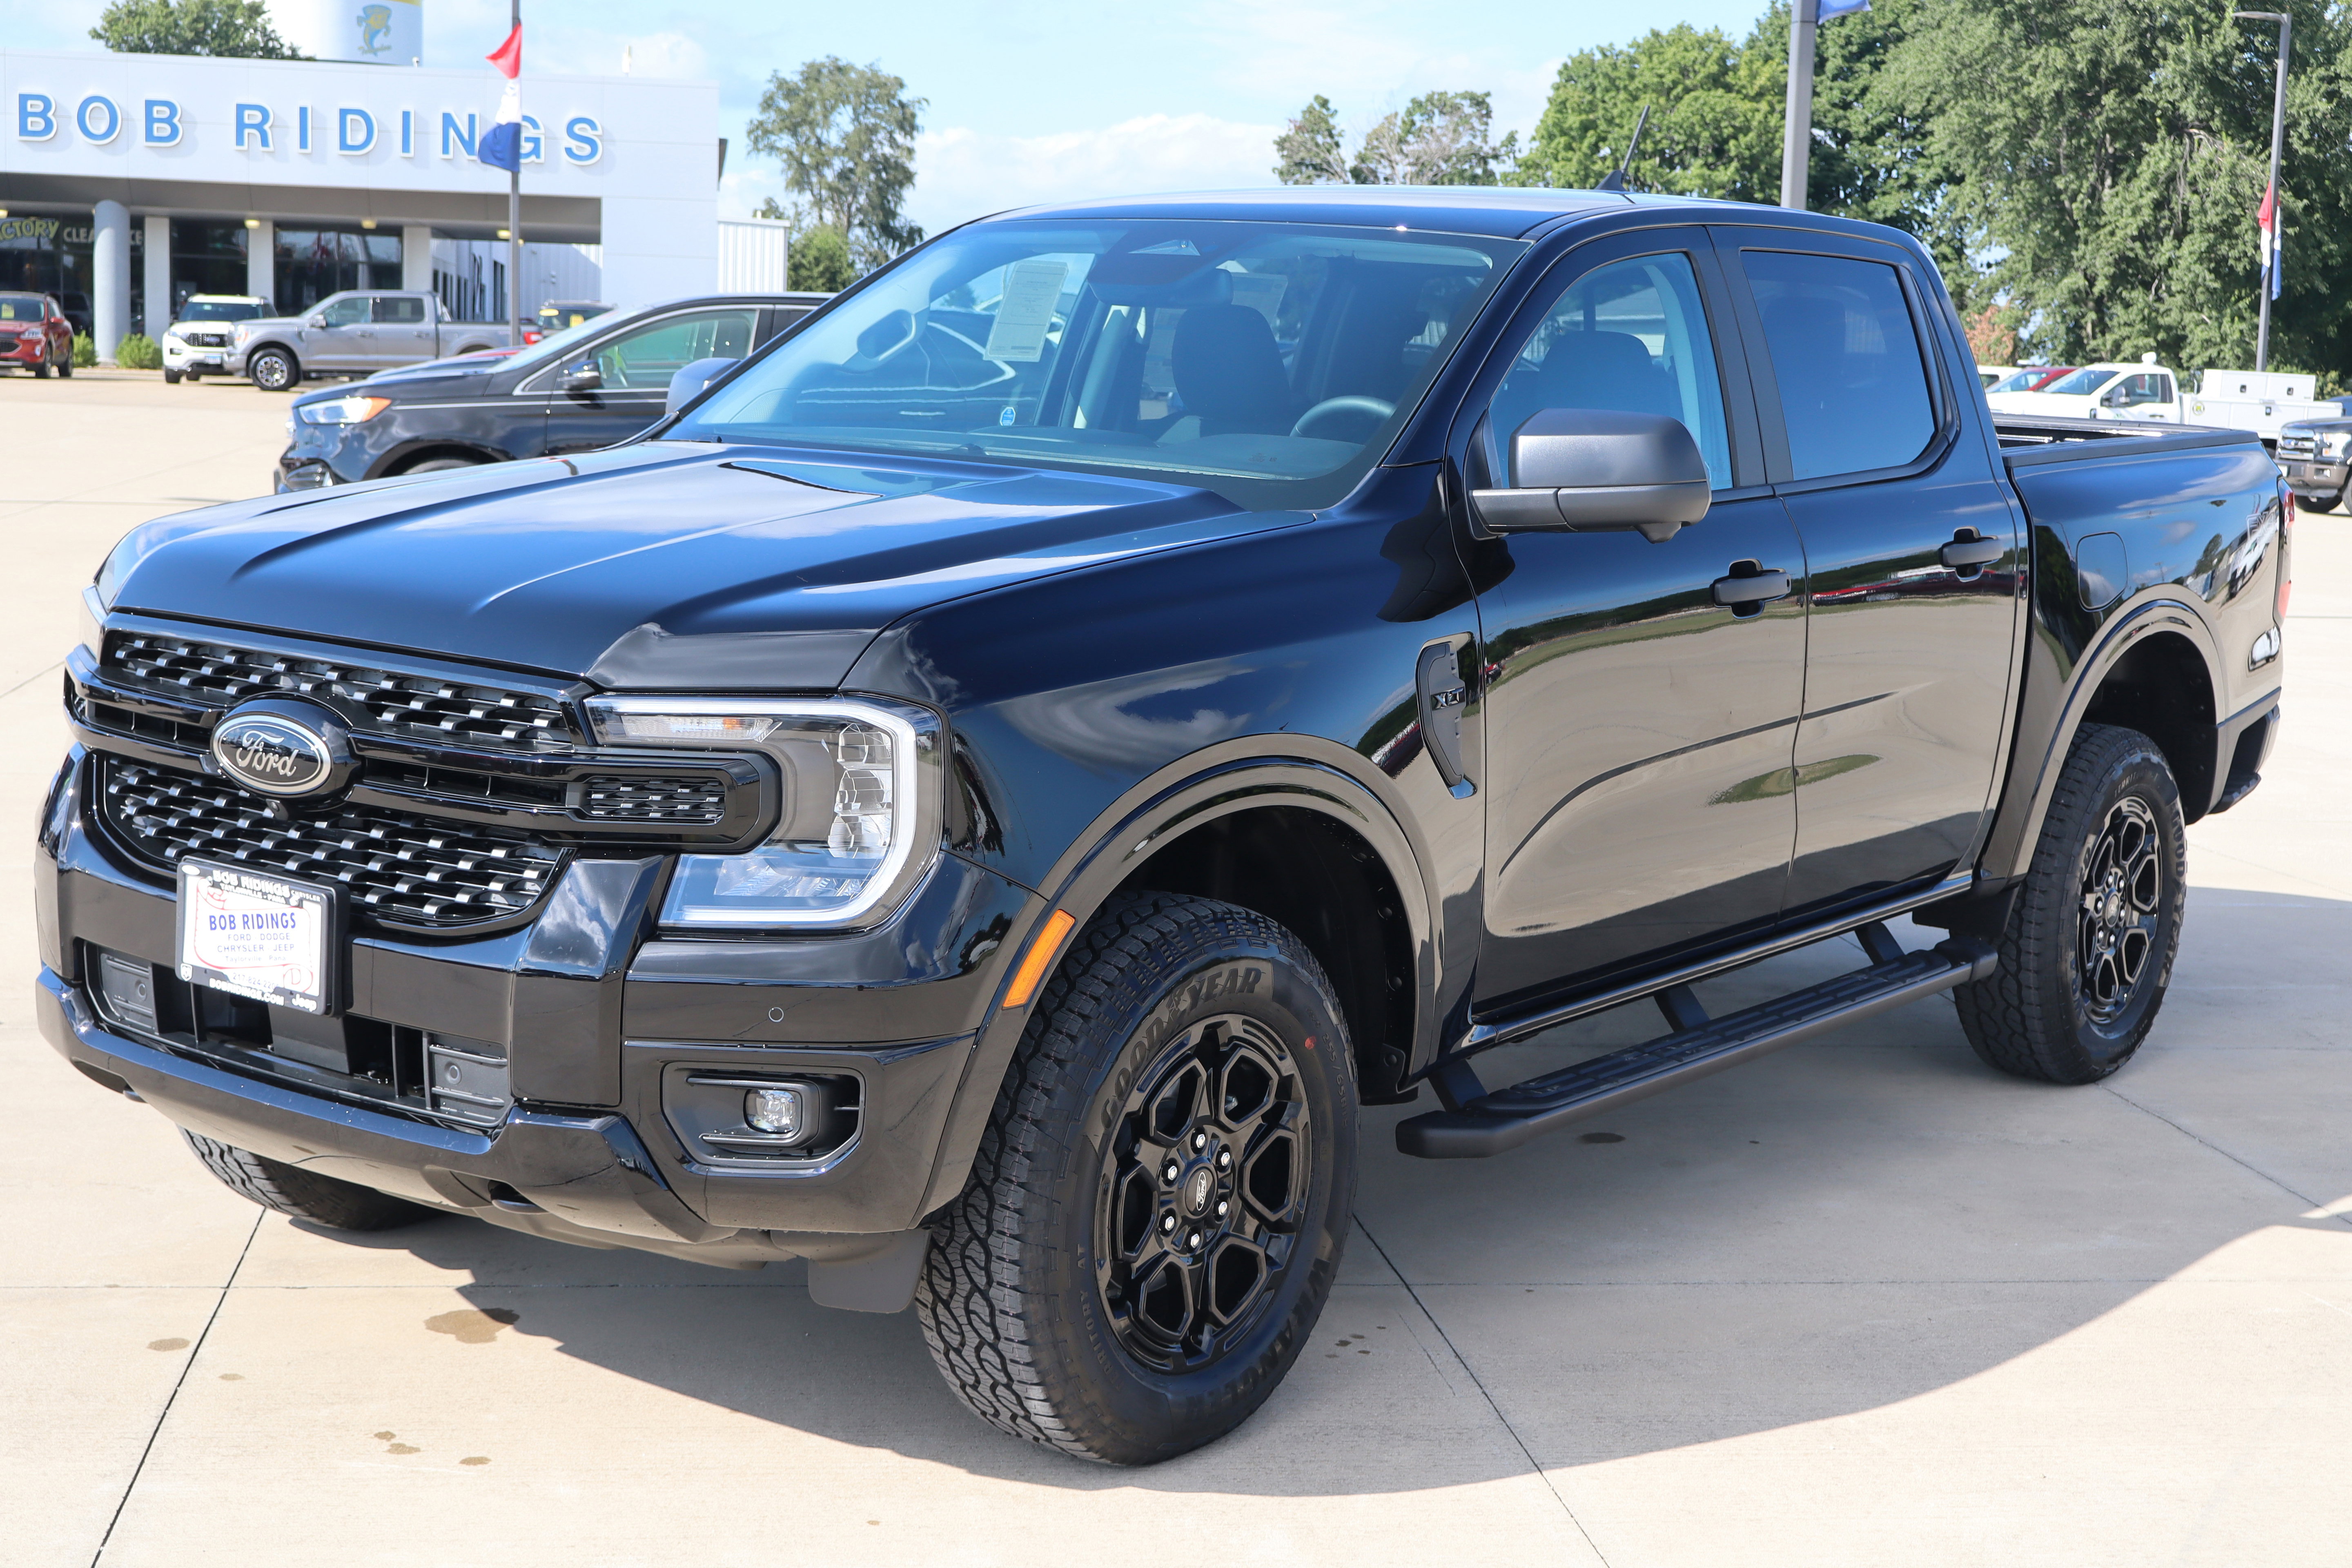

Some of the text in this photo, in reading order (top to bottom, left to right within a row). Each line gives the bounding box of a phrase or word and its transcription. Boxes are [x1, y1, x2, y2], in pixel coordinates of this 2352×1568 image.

[18, 91, 603, 166] BOB RIDINGS
[0, 219, 60, 240] CTORY
[2246, 511, 2276, 541] FX4
[1434, 688, 1463, 709] XLT
[236, 730, 299, 777] Ford
[212, 869, 291, 898] BOB RIDINGS
[220, 883, 263, 899] TAYLORVILLE
[267, 895, 286, 904] PANA
[290, 890, 321, 902] CHRYSLER
[209, 912, 296, 931] BOB RIDINGS
[217, 944, 265, 953] CHRYSLER
[292, 993, 317, 1012] Jeep
[1197, 1179, 1205, 1204] Ford
[1077, 1243, 1086, 1270] AT
